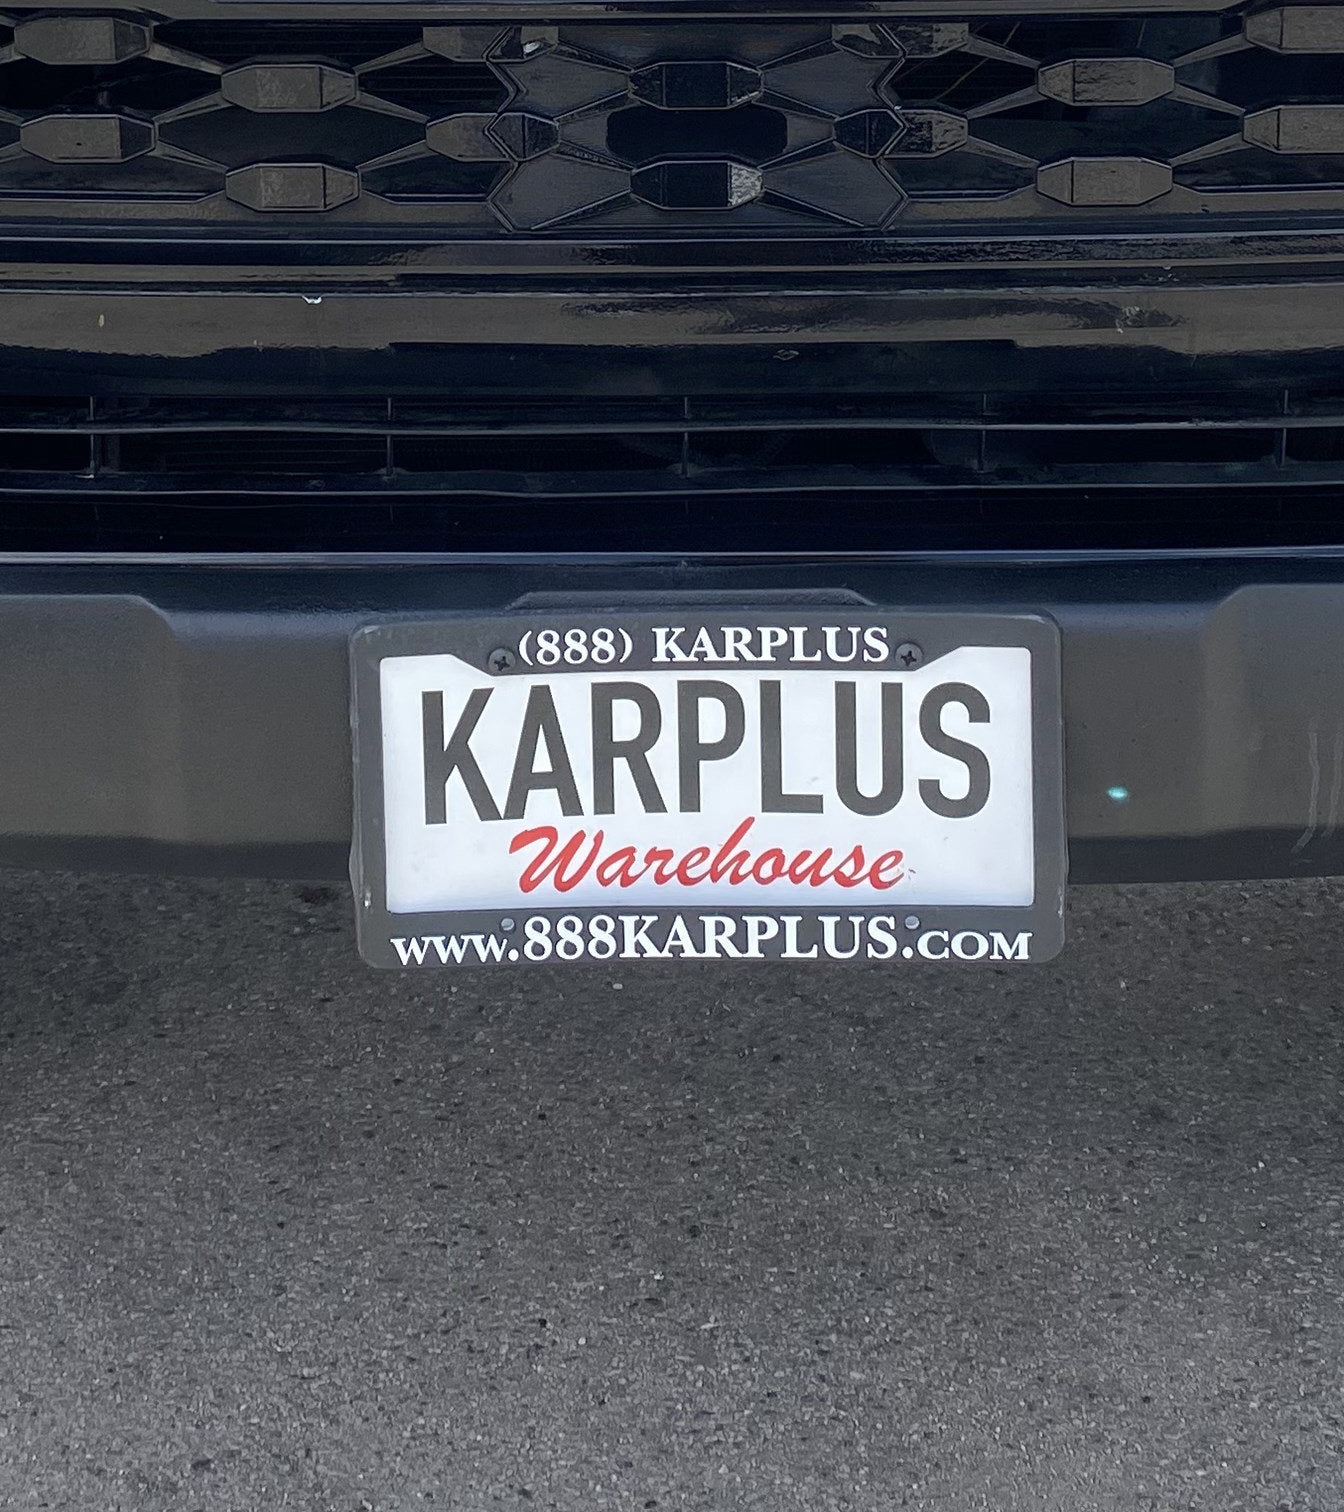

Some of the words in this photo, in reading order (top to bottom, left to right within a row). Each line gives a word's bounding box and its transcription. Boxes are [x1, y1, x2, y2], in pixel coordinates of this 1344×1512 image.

[517, 627, 634, 666] (888)
[651, 626, 890, 663] KARPLUS
[420, 679, 991, 826] KARPLUS
[509, 816, 903, 893] Warehouse
